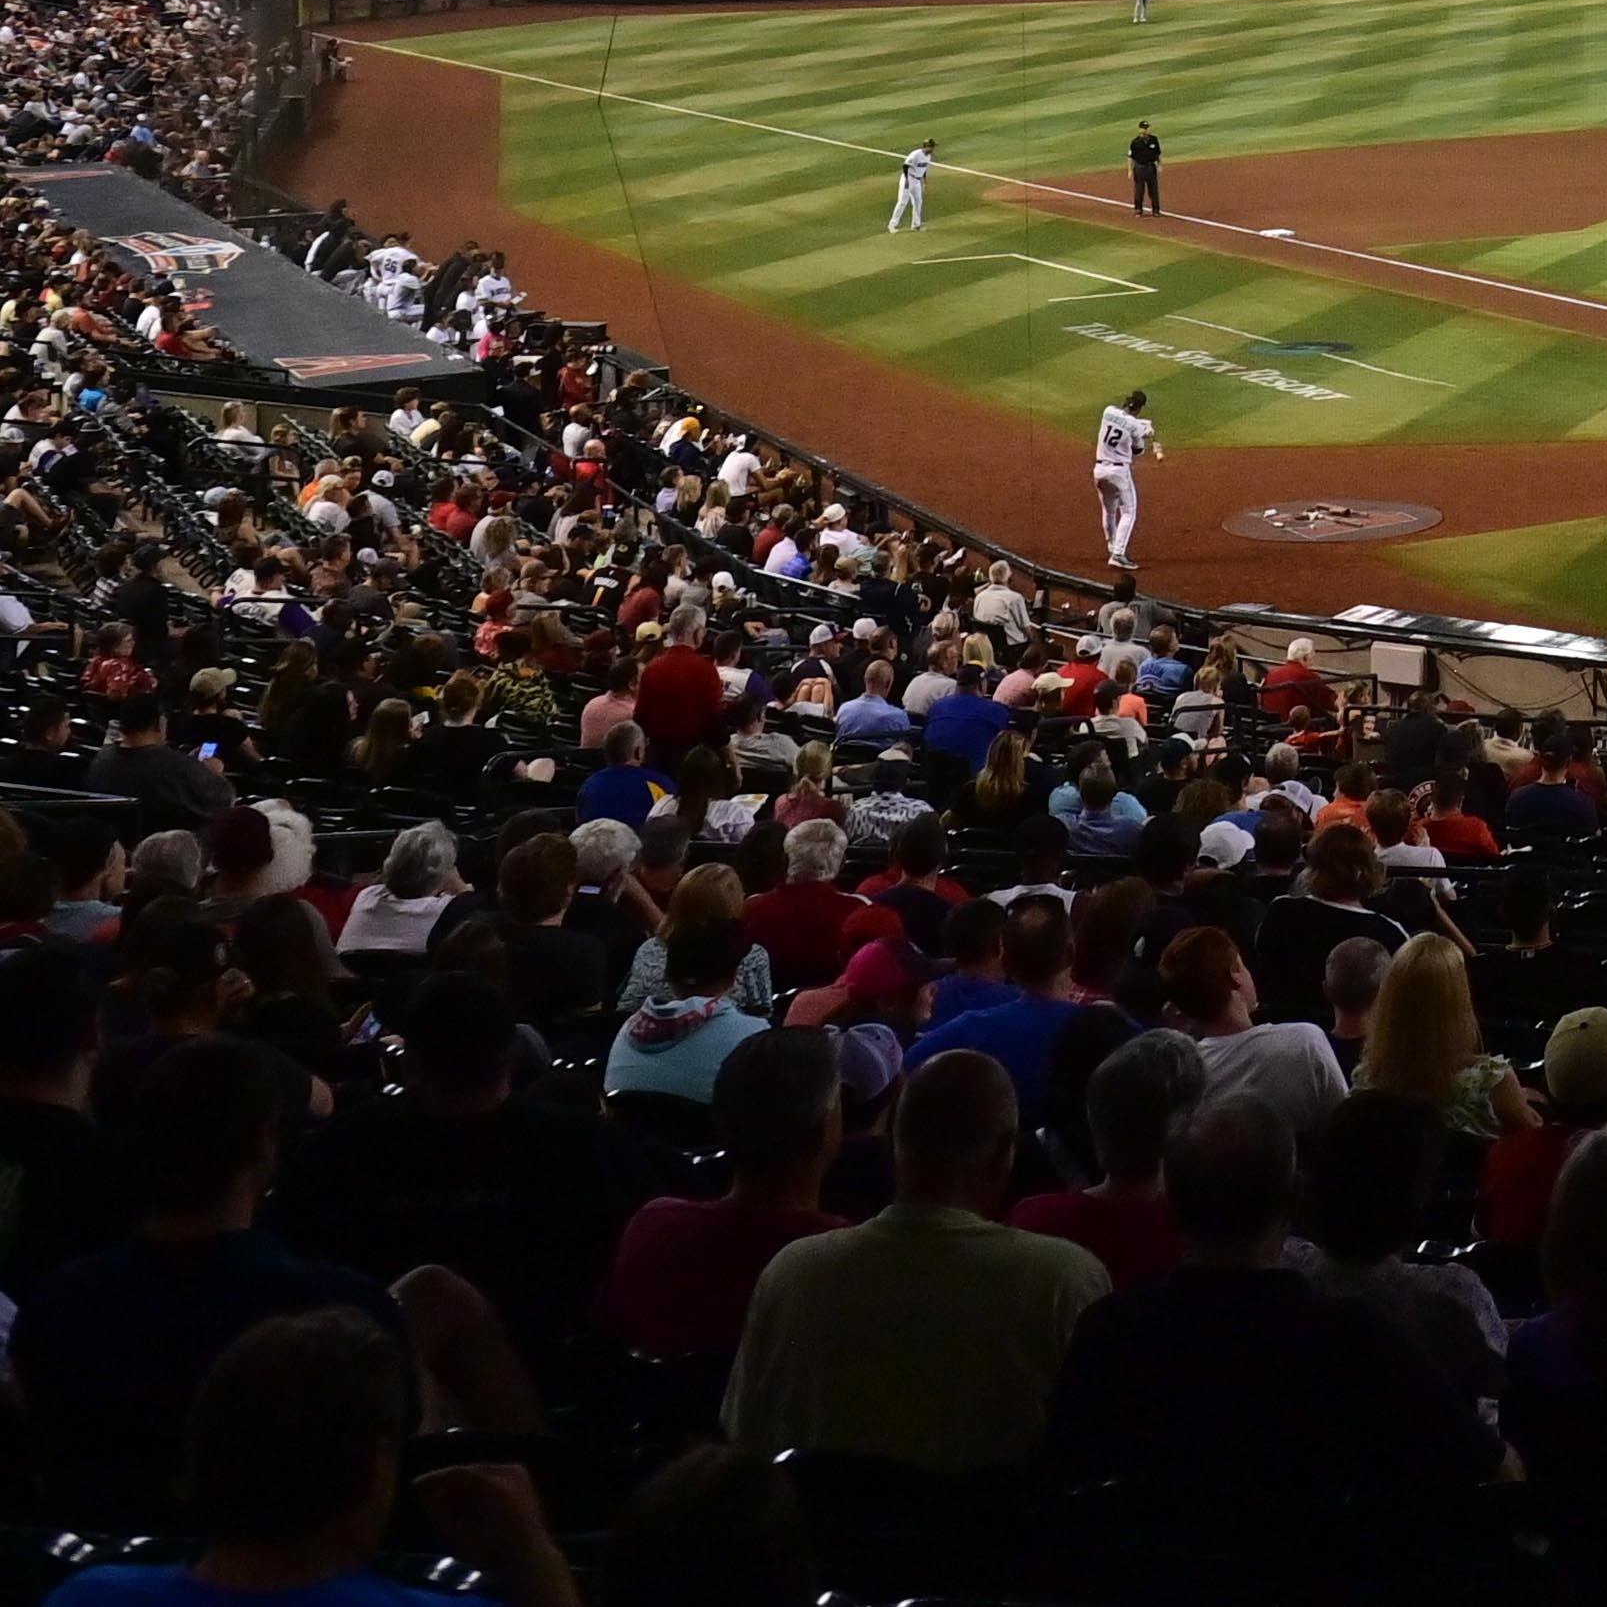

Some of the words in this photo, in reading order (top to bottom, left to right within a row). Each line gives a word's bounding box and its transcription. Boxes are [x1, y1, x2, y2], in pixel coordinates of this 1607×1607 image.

[384, 259, 398, 273] 26
[1157, 349, 1247, 374] STICK
[1229, 368, 1352, 400] RESORT
[1103, 424, 1123, 448] 12
